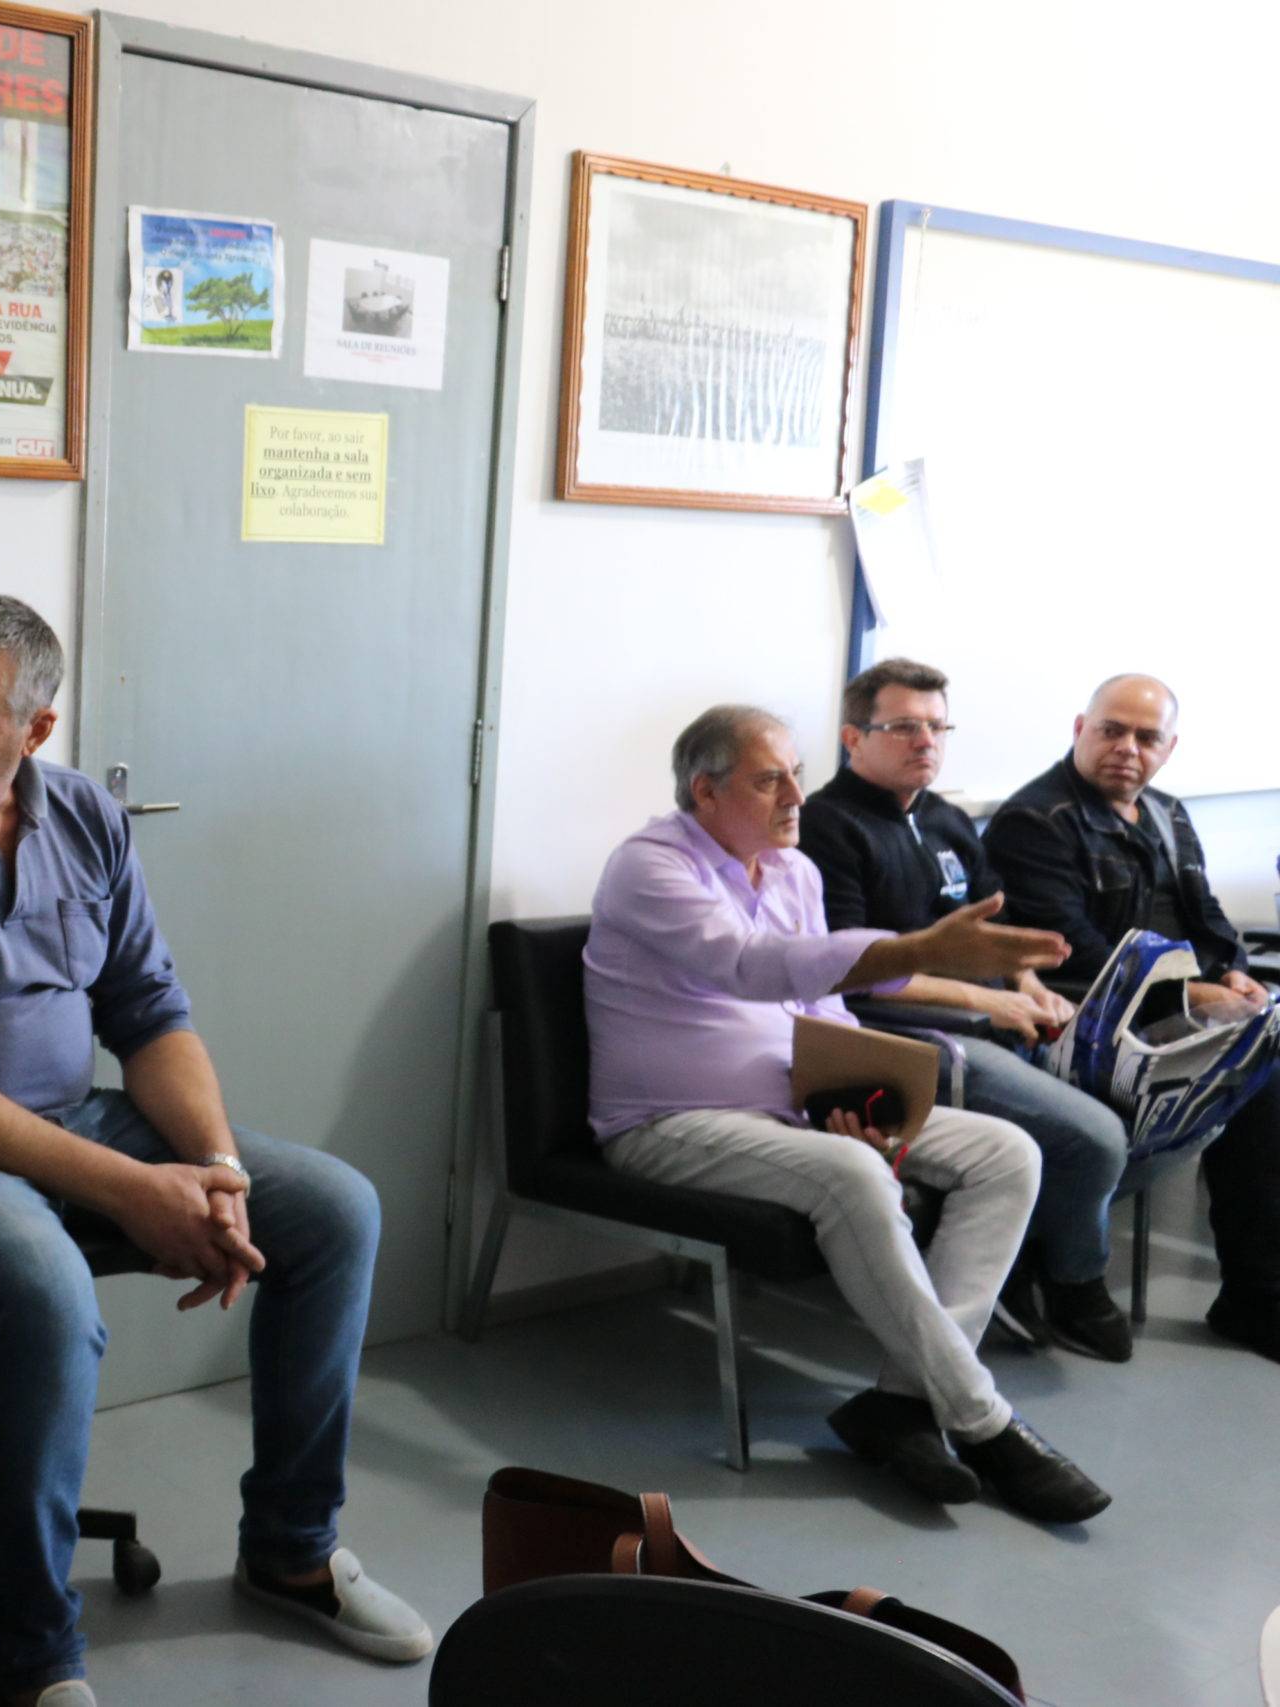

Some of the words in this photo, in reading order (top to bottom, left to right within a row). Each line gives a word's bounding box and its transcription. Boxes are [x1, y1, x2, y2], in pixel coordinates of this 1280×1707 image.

[8, 302, 43, 319] RUA
[269, 426, 289, 440] Por
[292, 427, 325, 443] favor,
[327, 433, 342, 444] ao
[344, 430, 365, 445] sair
[263, 446, 330, 462] mantenha
[333, 451, 341, 461] a
[344, 449, 369, 463] sala
[259, 465, 333, 480] organizada
[335, 471, 343, 481] e
[346, 472, 372, 482] sem
[282, 485, 357, 500] Agradecemos
[359, 491, 378, 502] sua
[279, 503, 351, 520] colaboração.
